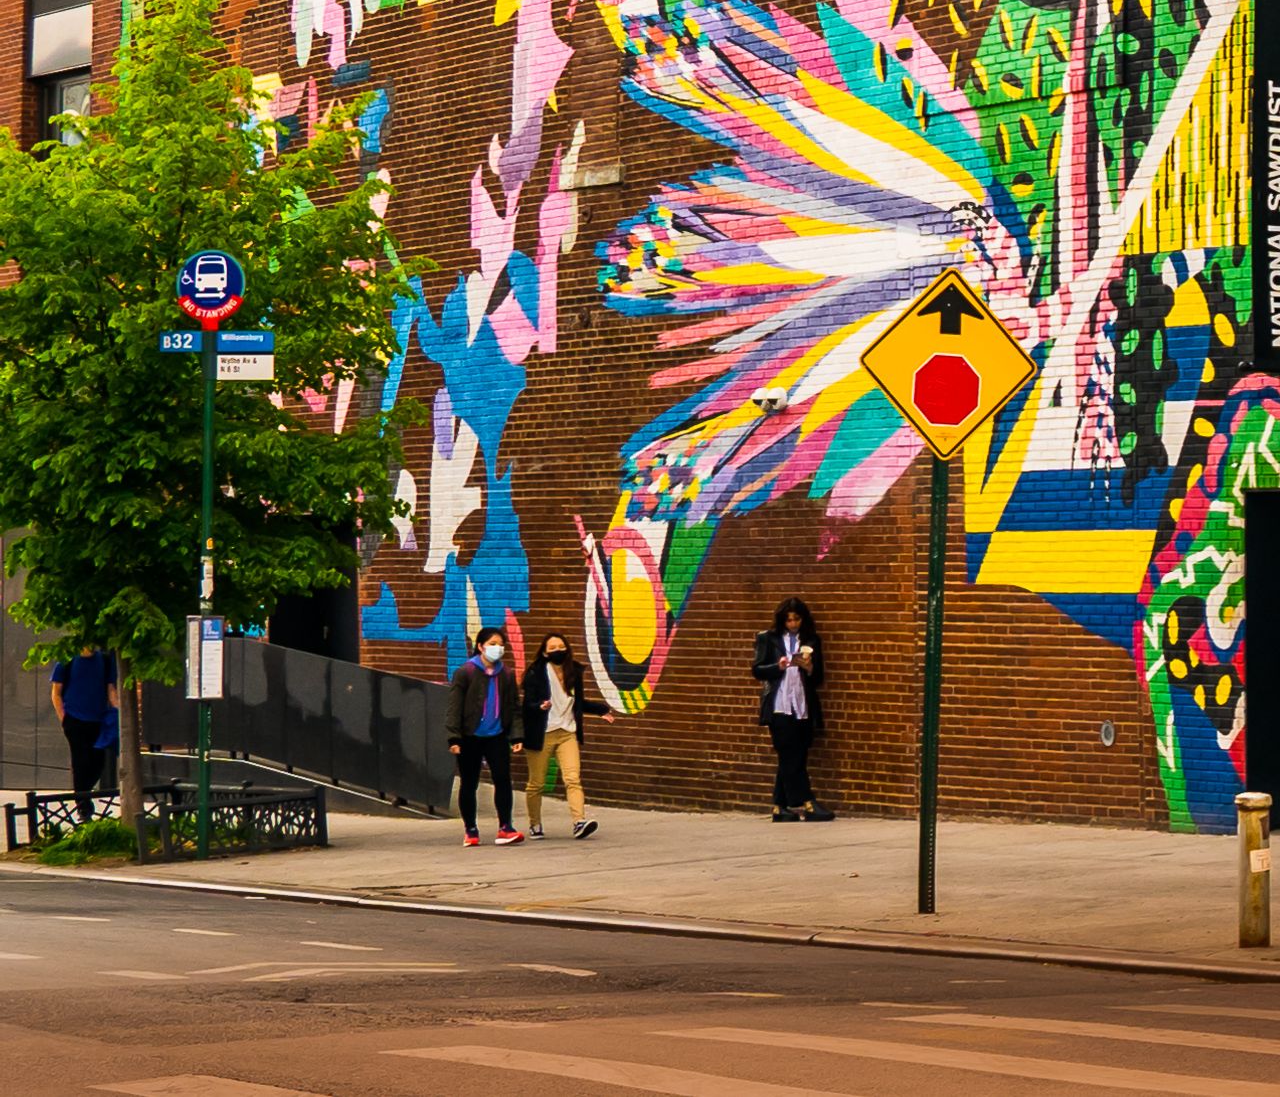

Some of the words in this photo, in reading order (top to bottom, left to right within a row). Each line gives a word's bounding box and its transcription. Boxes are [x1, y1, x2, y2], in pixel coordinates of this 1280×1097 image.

[183, 299, 194, 312] NO
[195, 299, 238, 318] STANDING
[163, 333, 193, 349] B32
